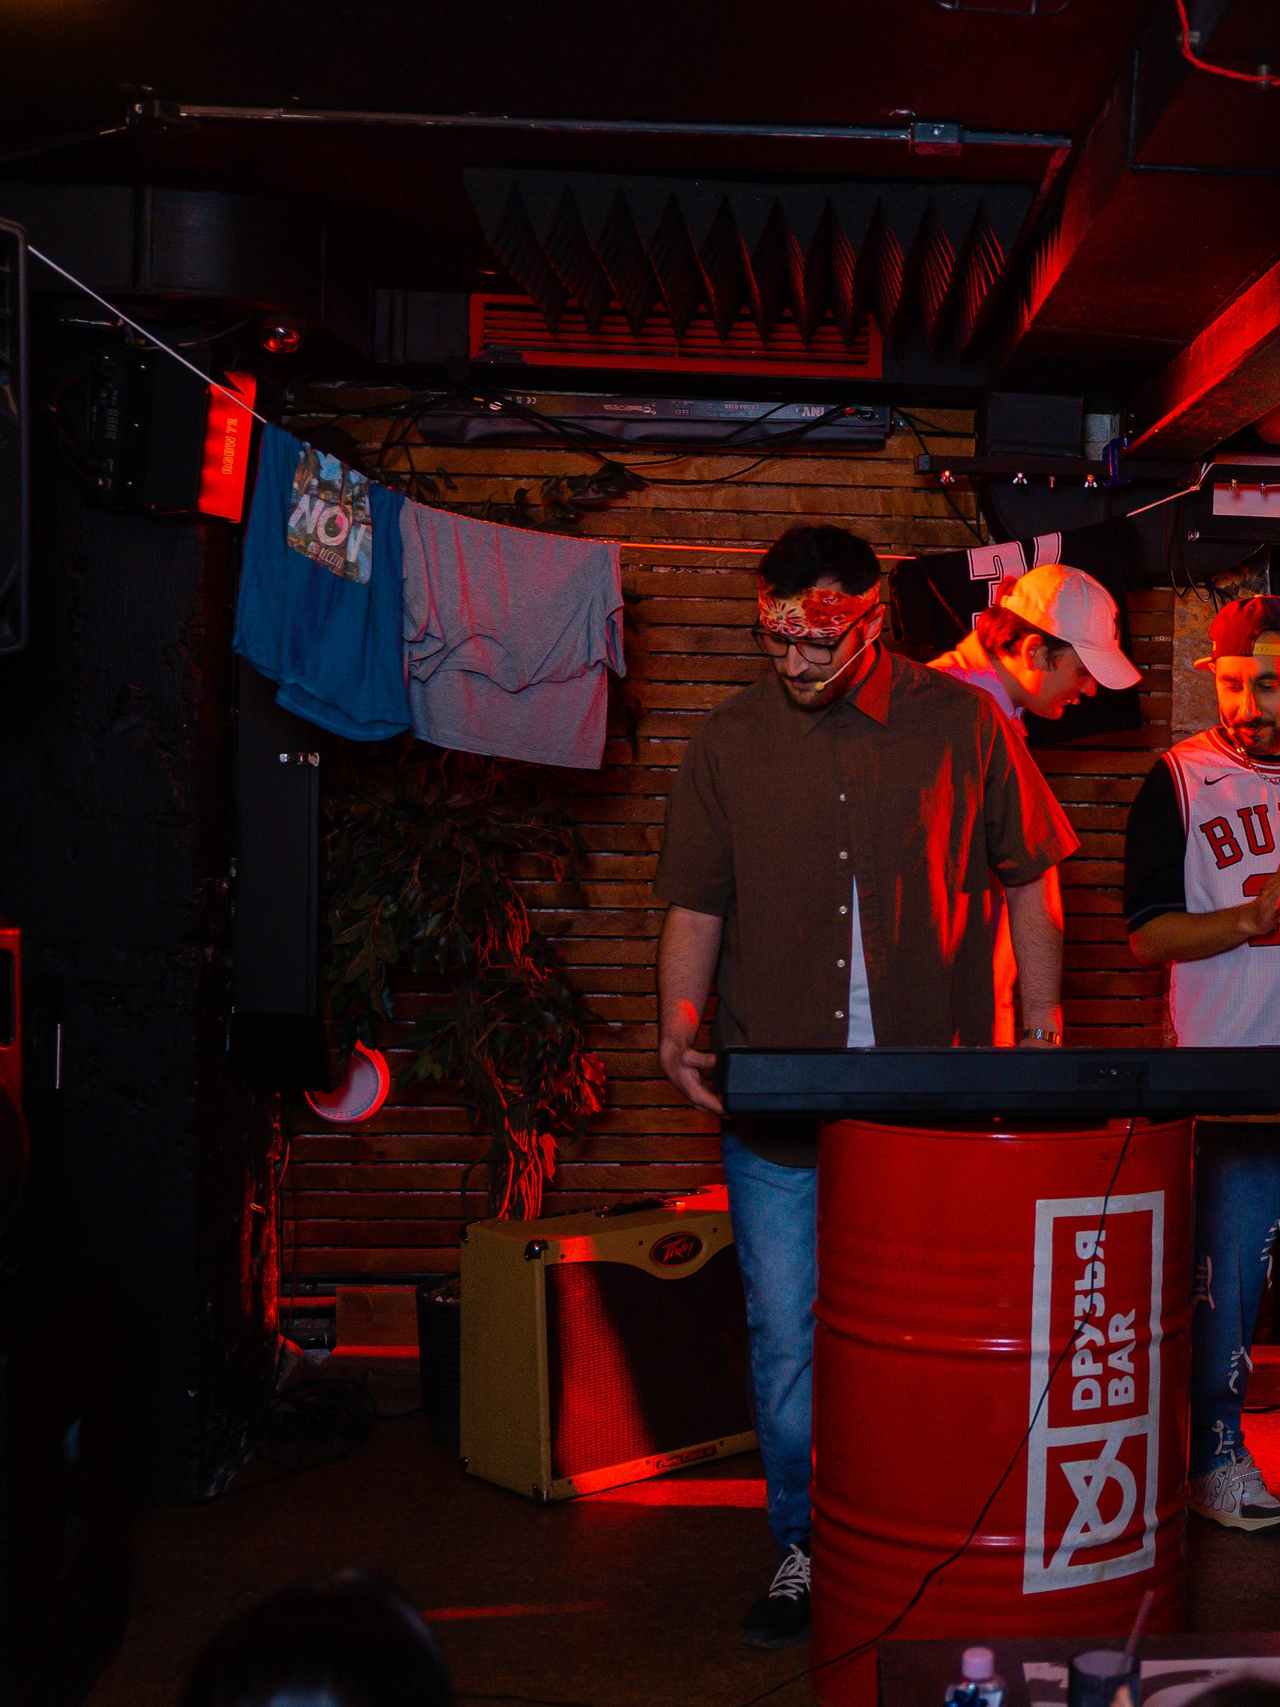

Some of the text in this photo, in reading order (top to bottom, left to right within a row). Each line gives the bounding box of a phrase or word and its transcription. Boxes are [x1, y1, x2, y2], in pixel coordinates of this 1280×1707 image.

[221, 417, 239, 475] RGBW 72
[1107, 1307, 1137, 1407] BAR
